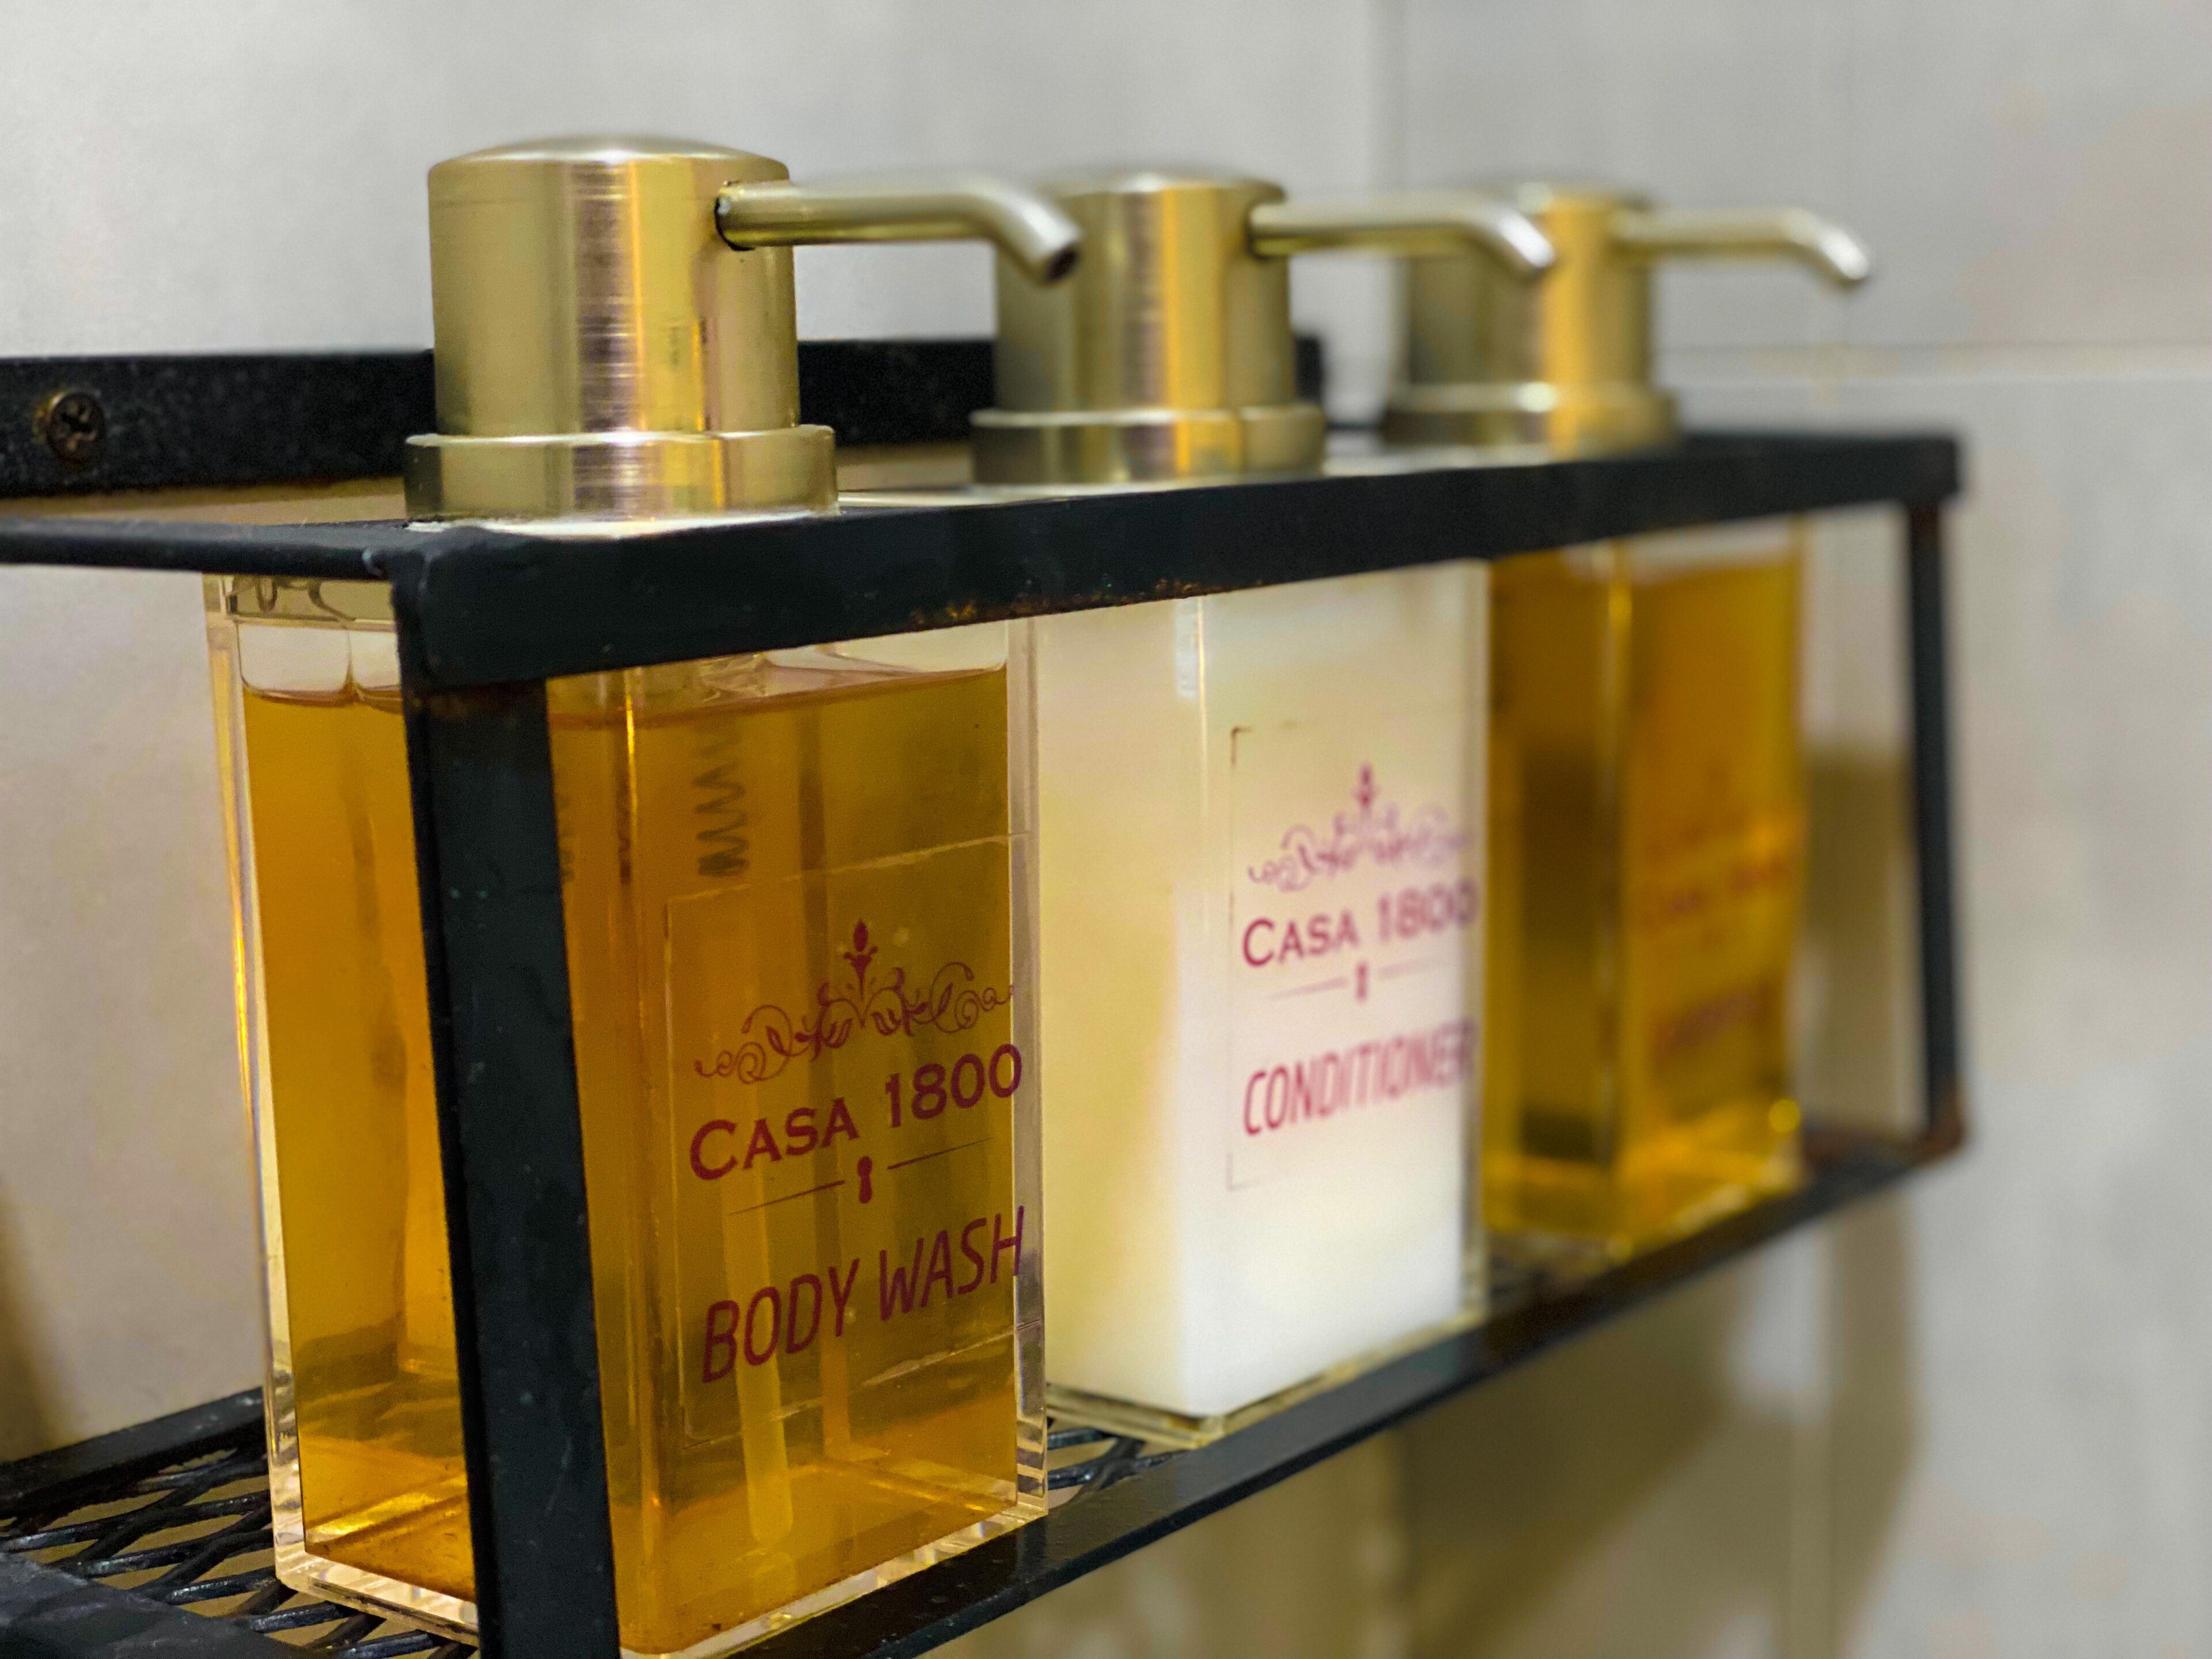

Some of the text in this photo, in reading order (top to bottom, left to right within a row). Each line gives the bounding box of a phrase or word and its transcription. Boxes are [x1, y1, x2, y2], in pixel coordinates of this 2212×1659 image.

[1241, 878, 1480, 968] CASA 1800
[690, 1043, 1022, 1180] CASA 1800
[1243, 1015, 1479, 1135] CONDITIONER
[702, 1205, 1025, 1382] BODY WASH
